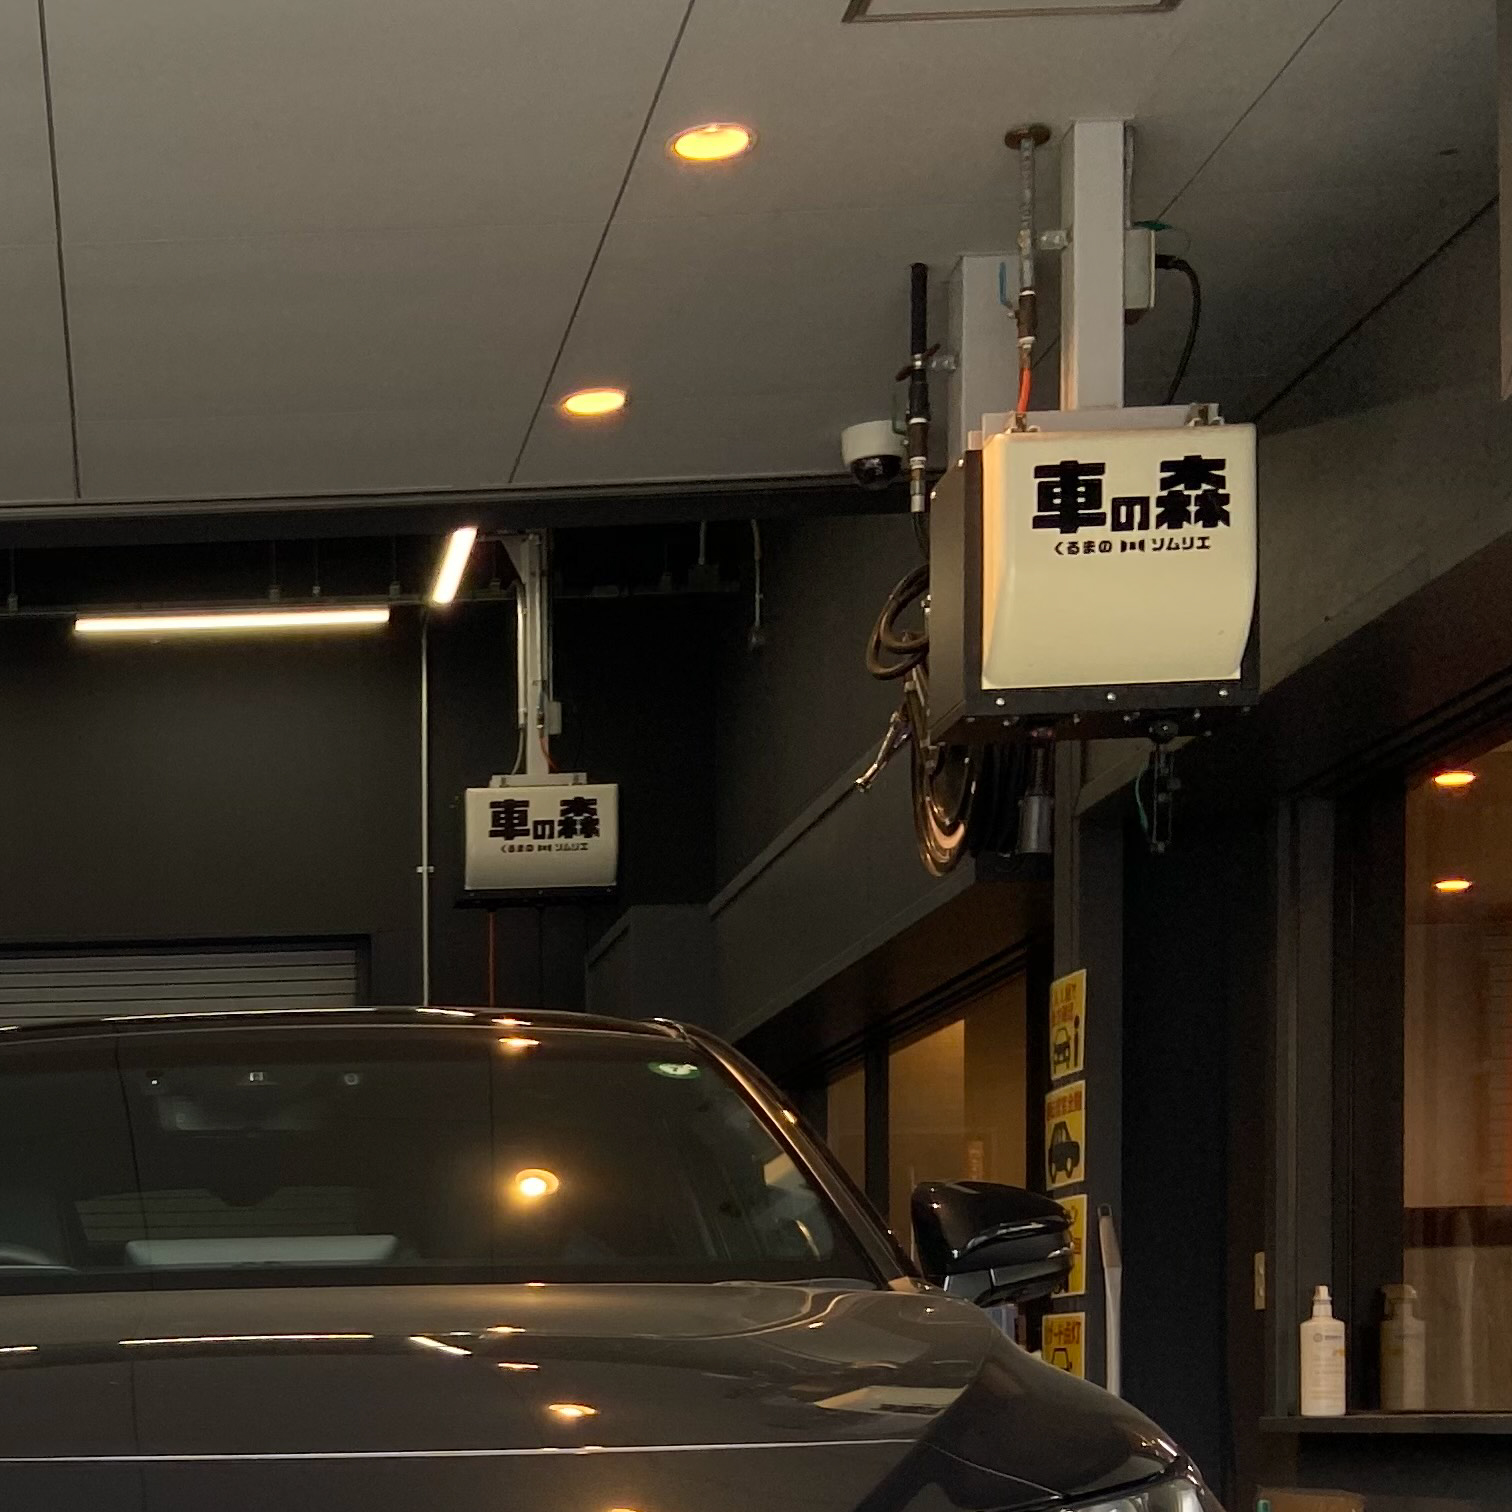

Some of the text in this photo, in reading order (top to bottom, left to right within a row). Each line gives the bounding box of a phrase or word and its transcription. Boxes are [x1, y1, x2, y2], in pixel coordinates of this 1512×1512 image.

[1032, 455, 1230, 534] 車の森
[1054, 536, 1211, 556] くるまの ソムリエ
[489, 796, 600, 840] 車の森
